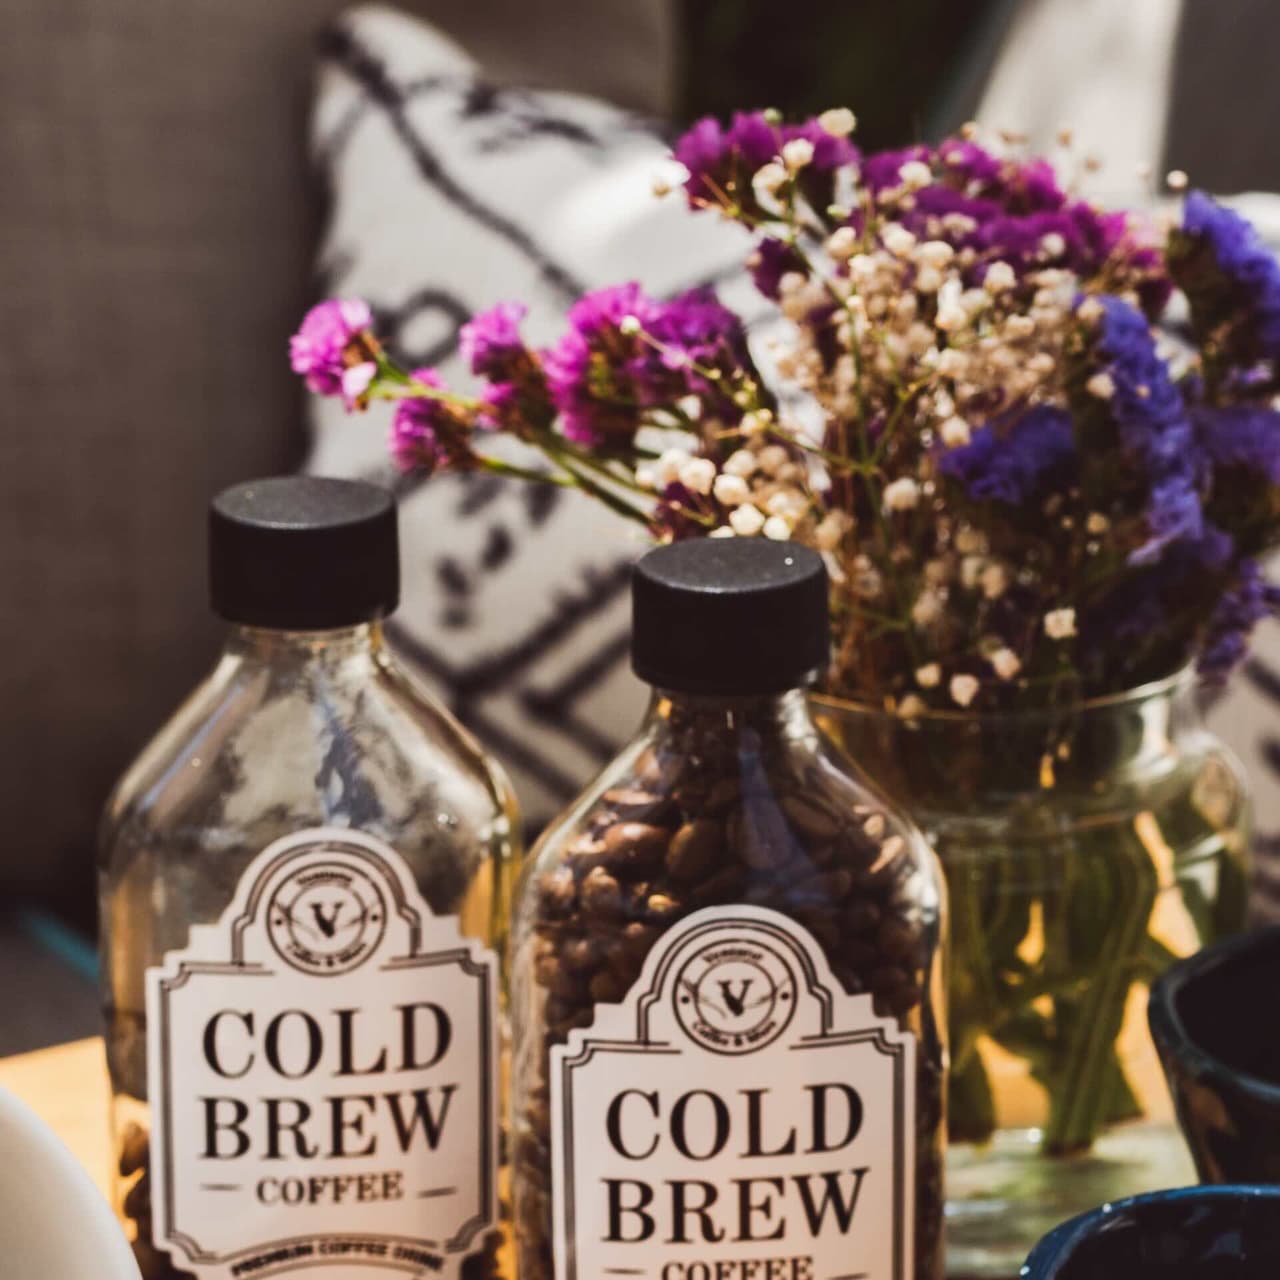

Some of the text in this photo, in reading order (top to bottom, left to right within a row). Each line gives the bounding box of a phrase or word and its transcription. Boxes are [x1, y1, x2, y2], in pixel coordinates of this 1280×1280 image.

[311, 902, 344, 938] V
[718, 979, 753, 1016] V
[201, 1001, 454, 1080] COLD
[197, 1082, 460, 1161] BREW
[605, 1081, 866, 1162] COLD
[255, 1170, 405, 1206] COFFEE
[600, 1165, 871, 1246] BREW
